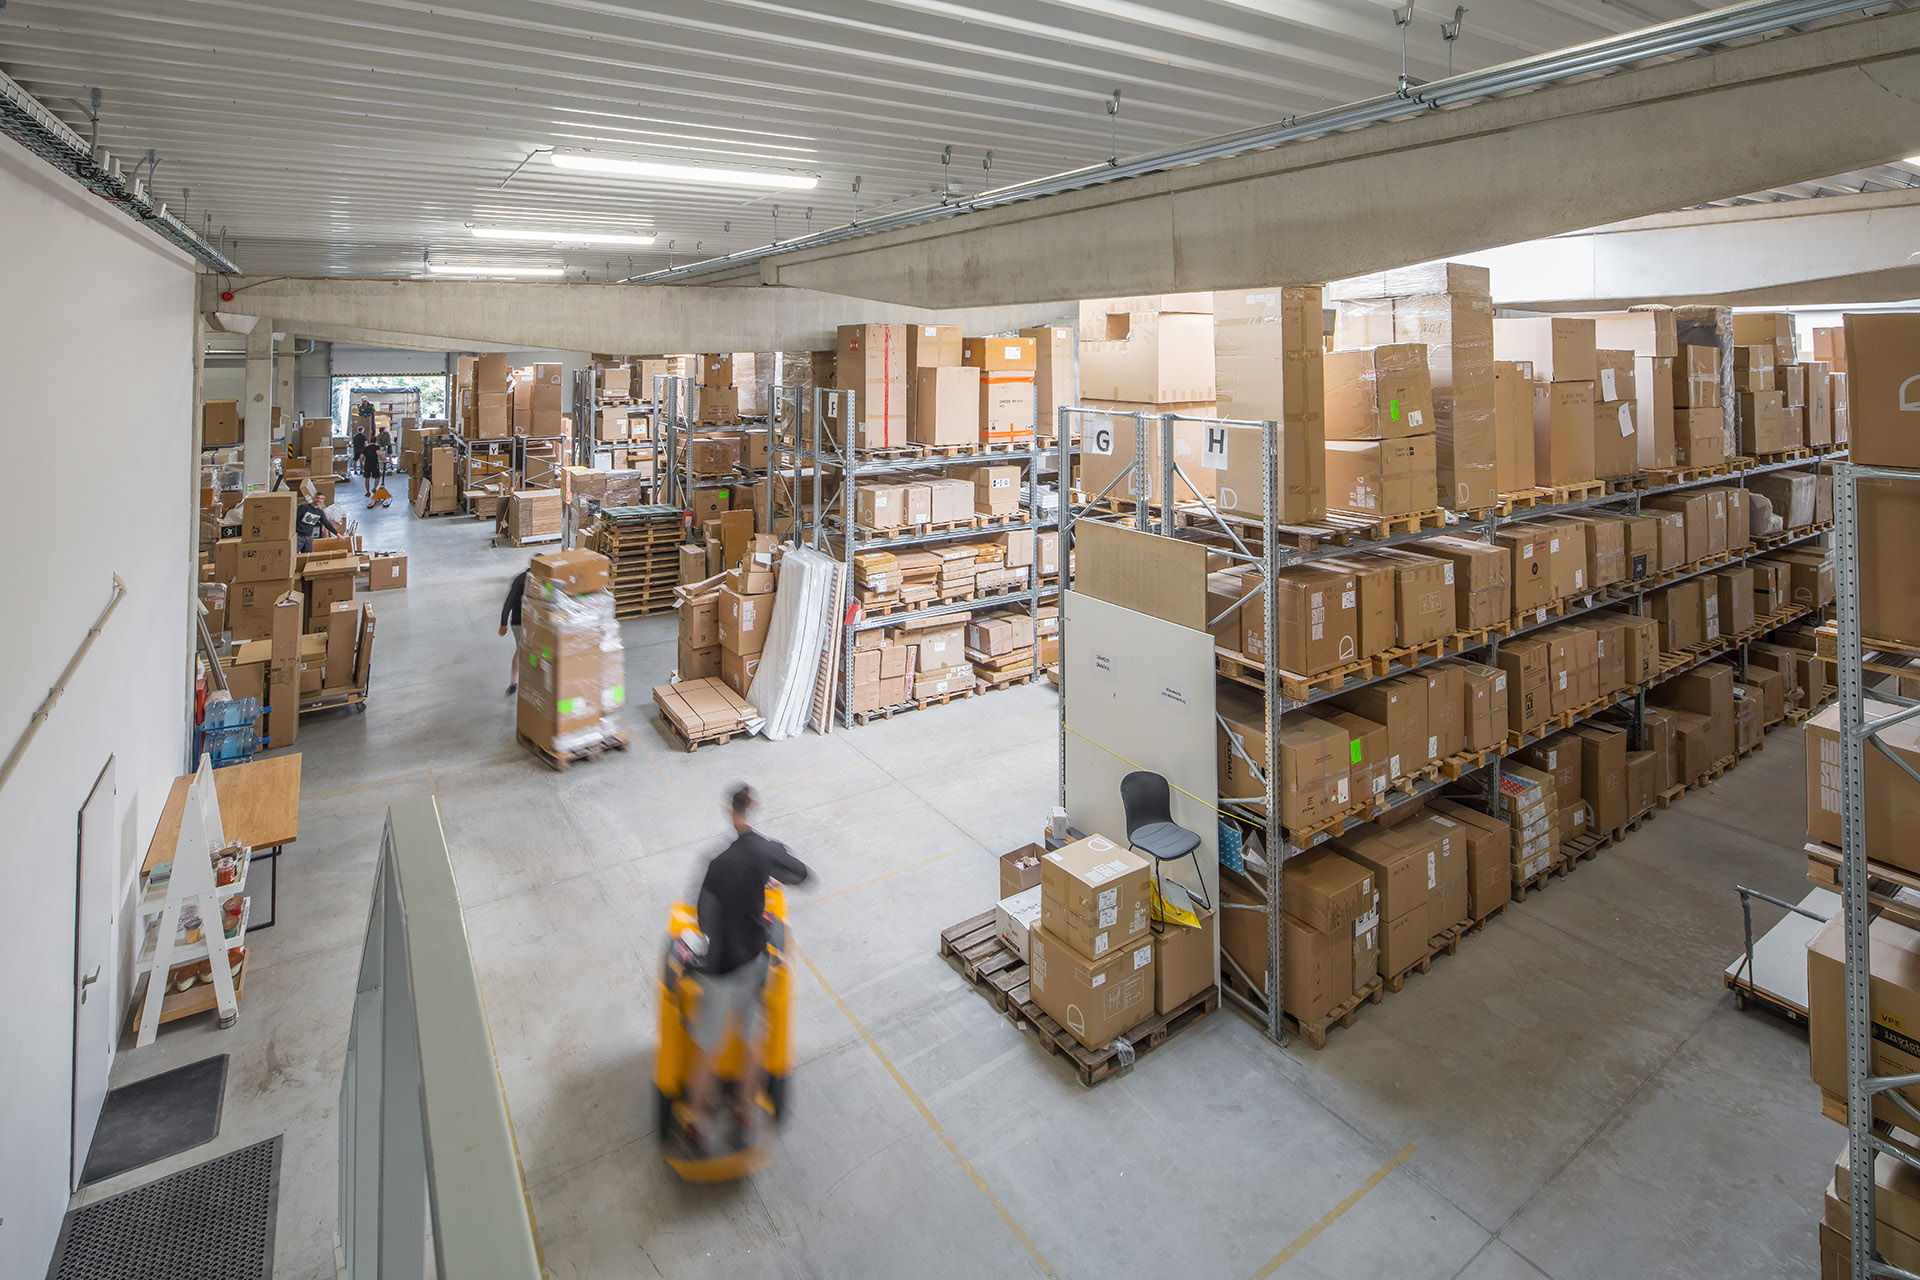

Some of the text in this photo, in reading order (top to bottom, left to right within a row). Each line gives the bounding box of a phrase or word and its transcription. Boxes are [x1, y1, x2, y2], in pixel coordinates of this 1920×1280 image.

[831, 402, 835, 415] F
[1096, 430, 1110, 452] G
[1208, 428, 1224, 454] H
[1881, 1014, 1900, 1028] VPE
